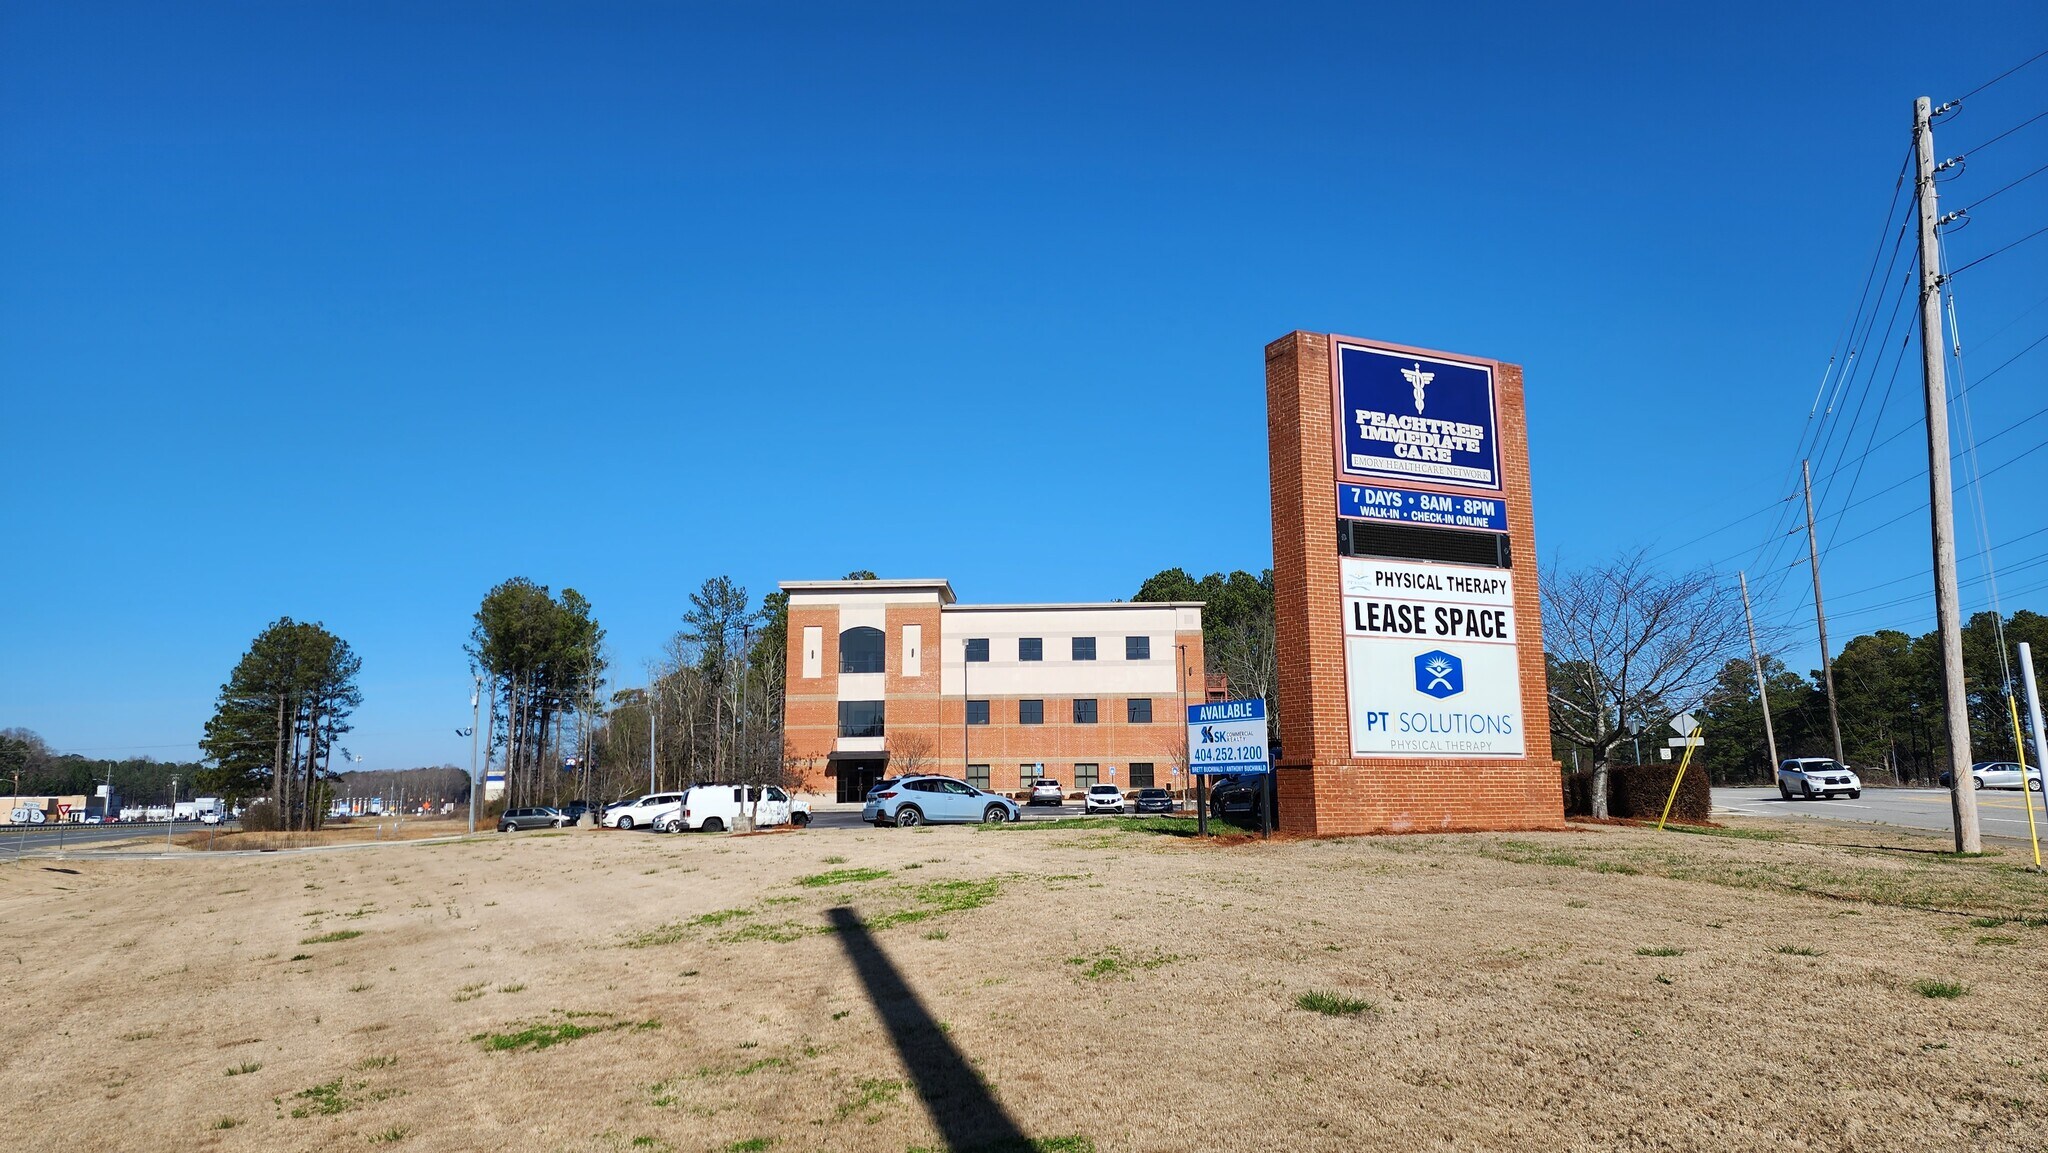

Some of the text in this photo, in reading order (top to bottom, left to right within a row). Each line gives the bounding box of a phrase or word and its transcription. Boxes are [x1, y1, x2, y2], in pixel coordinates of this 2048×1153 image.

[1355, 409, 1483, 440] PEACHTREE
[1360, 424, 1480, 453] IMMEDIATE
[1394, 444, 1451, 462] CARE
[1353, 456, 1490, 480] EMORY HEALTHCARE NETWORK
[1351, 488, 1361, 503] 7
[1365, 489, 1402, 507] DAYS
[1420, 494, 1452, 512] 8AM
[1464, 499, 1495, 517] 8PM
[1360, 506, 1489, 528] WALK-IN CHECK-IN ONLINE
[1375, 570, 1507, 596] PHYSICAL THERAPY
[1354, 601, 1508, 639] LEASE SPACE
[1200, 702, 1253, 721] AVAILABLE
[1367, 711, 1512, 735] PT SOLUTIONS
[1214, 730, 1226, 743] SK
[1390, 739, 1492, 752] PHYSICAL THERAPY
[1194, 746, 1262, 762] 404.252.1200
[14, 811, 26, 819] 41
[33, 812, 40, 820] 3
